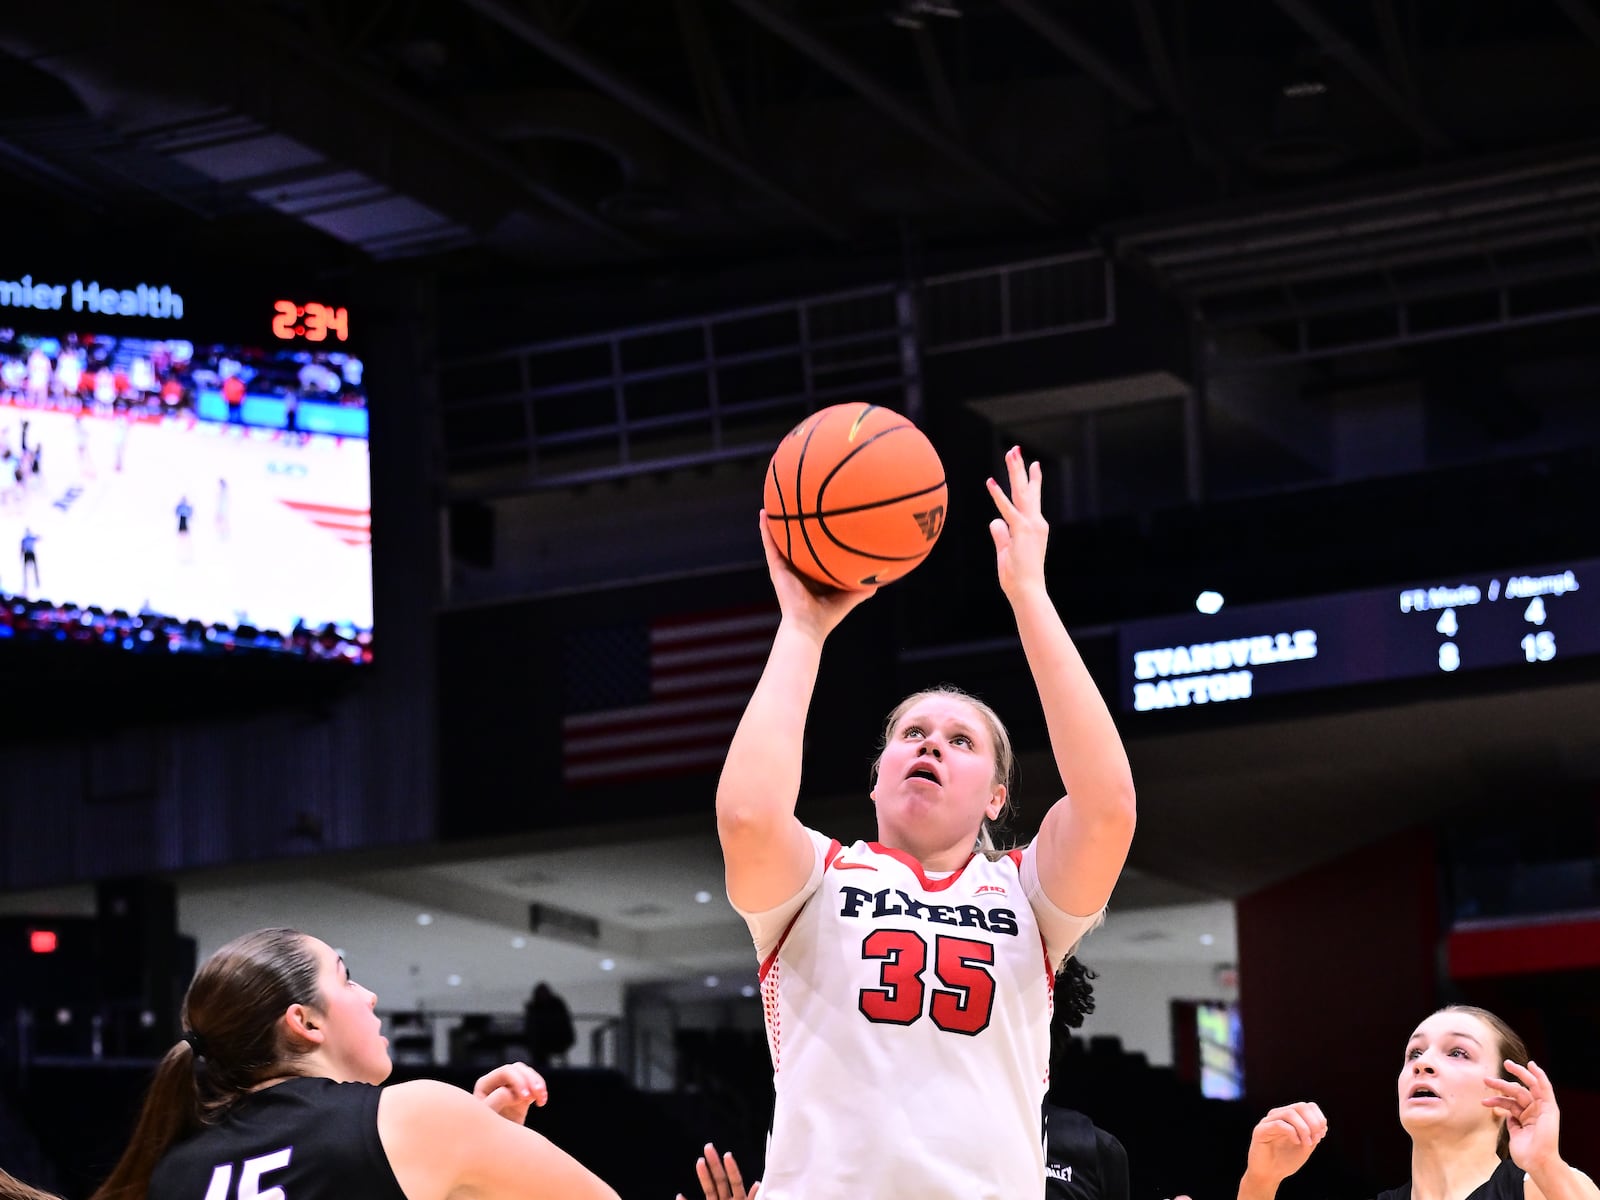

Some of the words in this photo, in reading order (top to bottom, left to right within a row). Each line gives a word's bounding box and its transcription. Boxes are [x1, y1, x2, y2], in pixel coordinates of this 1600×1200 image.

[71, 279, 184, 319] Health
[272, 300, 348, 341] 2:34
[1134, 629, 1317, 679] EVANSVILLE
[1134, 670, 1253, 711] DAYTON
[839, 886, 1018, 936] FLYERS
[858, 928, 996, 1037] 35
